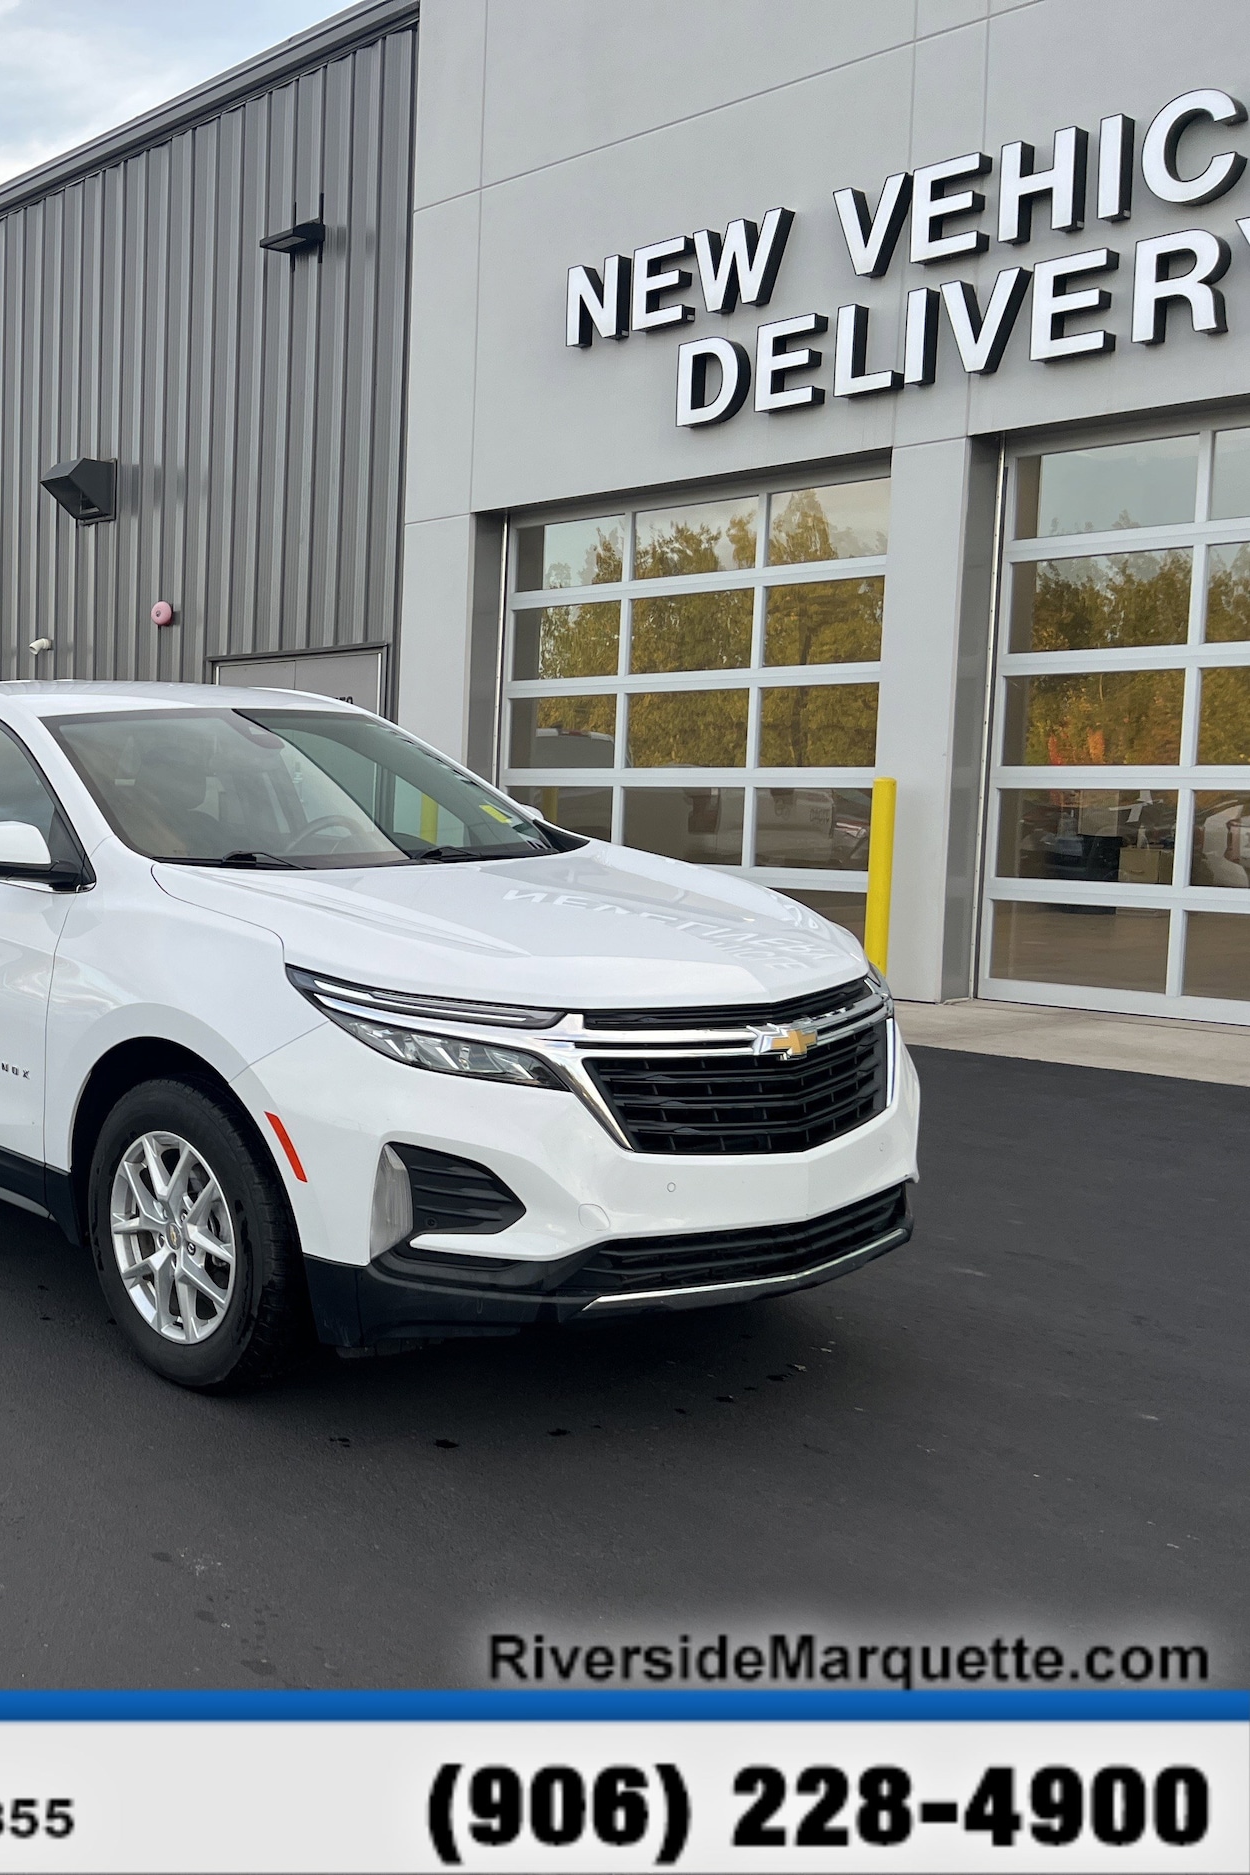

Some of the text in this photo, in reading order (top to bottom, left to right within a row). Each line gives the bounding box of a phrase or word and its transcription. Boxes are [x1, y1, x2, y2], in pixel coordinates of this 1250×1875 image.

[566, 87, 1249, 348] NEW VEHIC
[675, 216, 1250, 428] DELIVER
